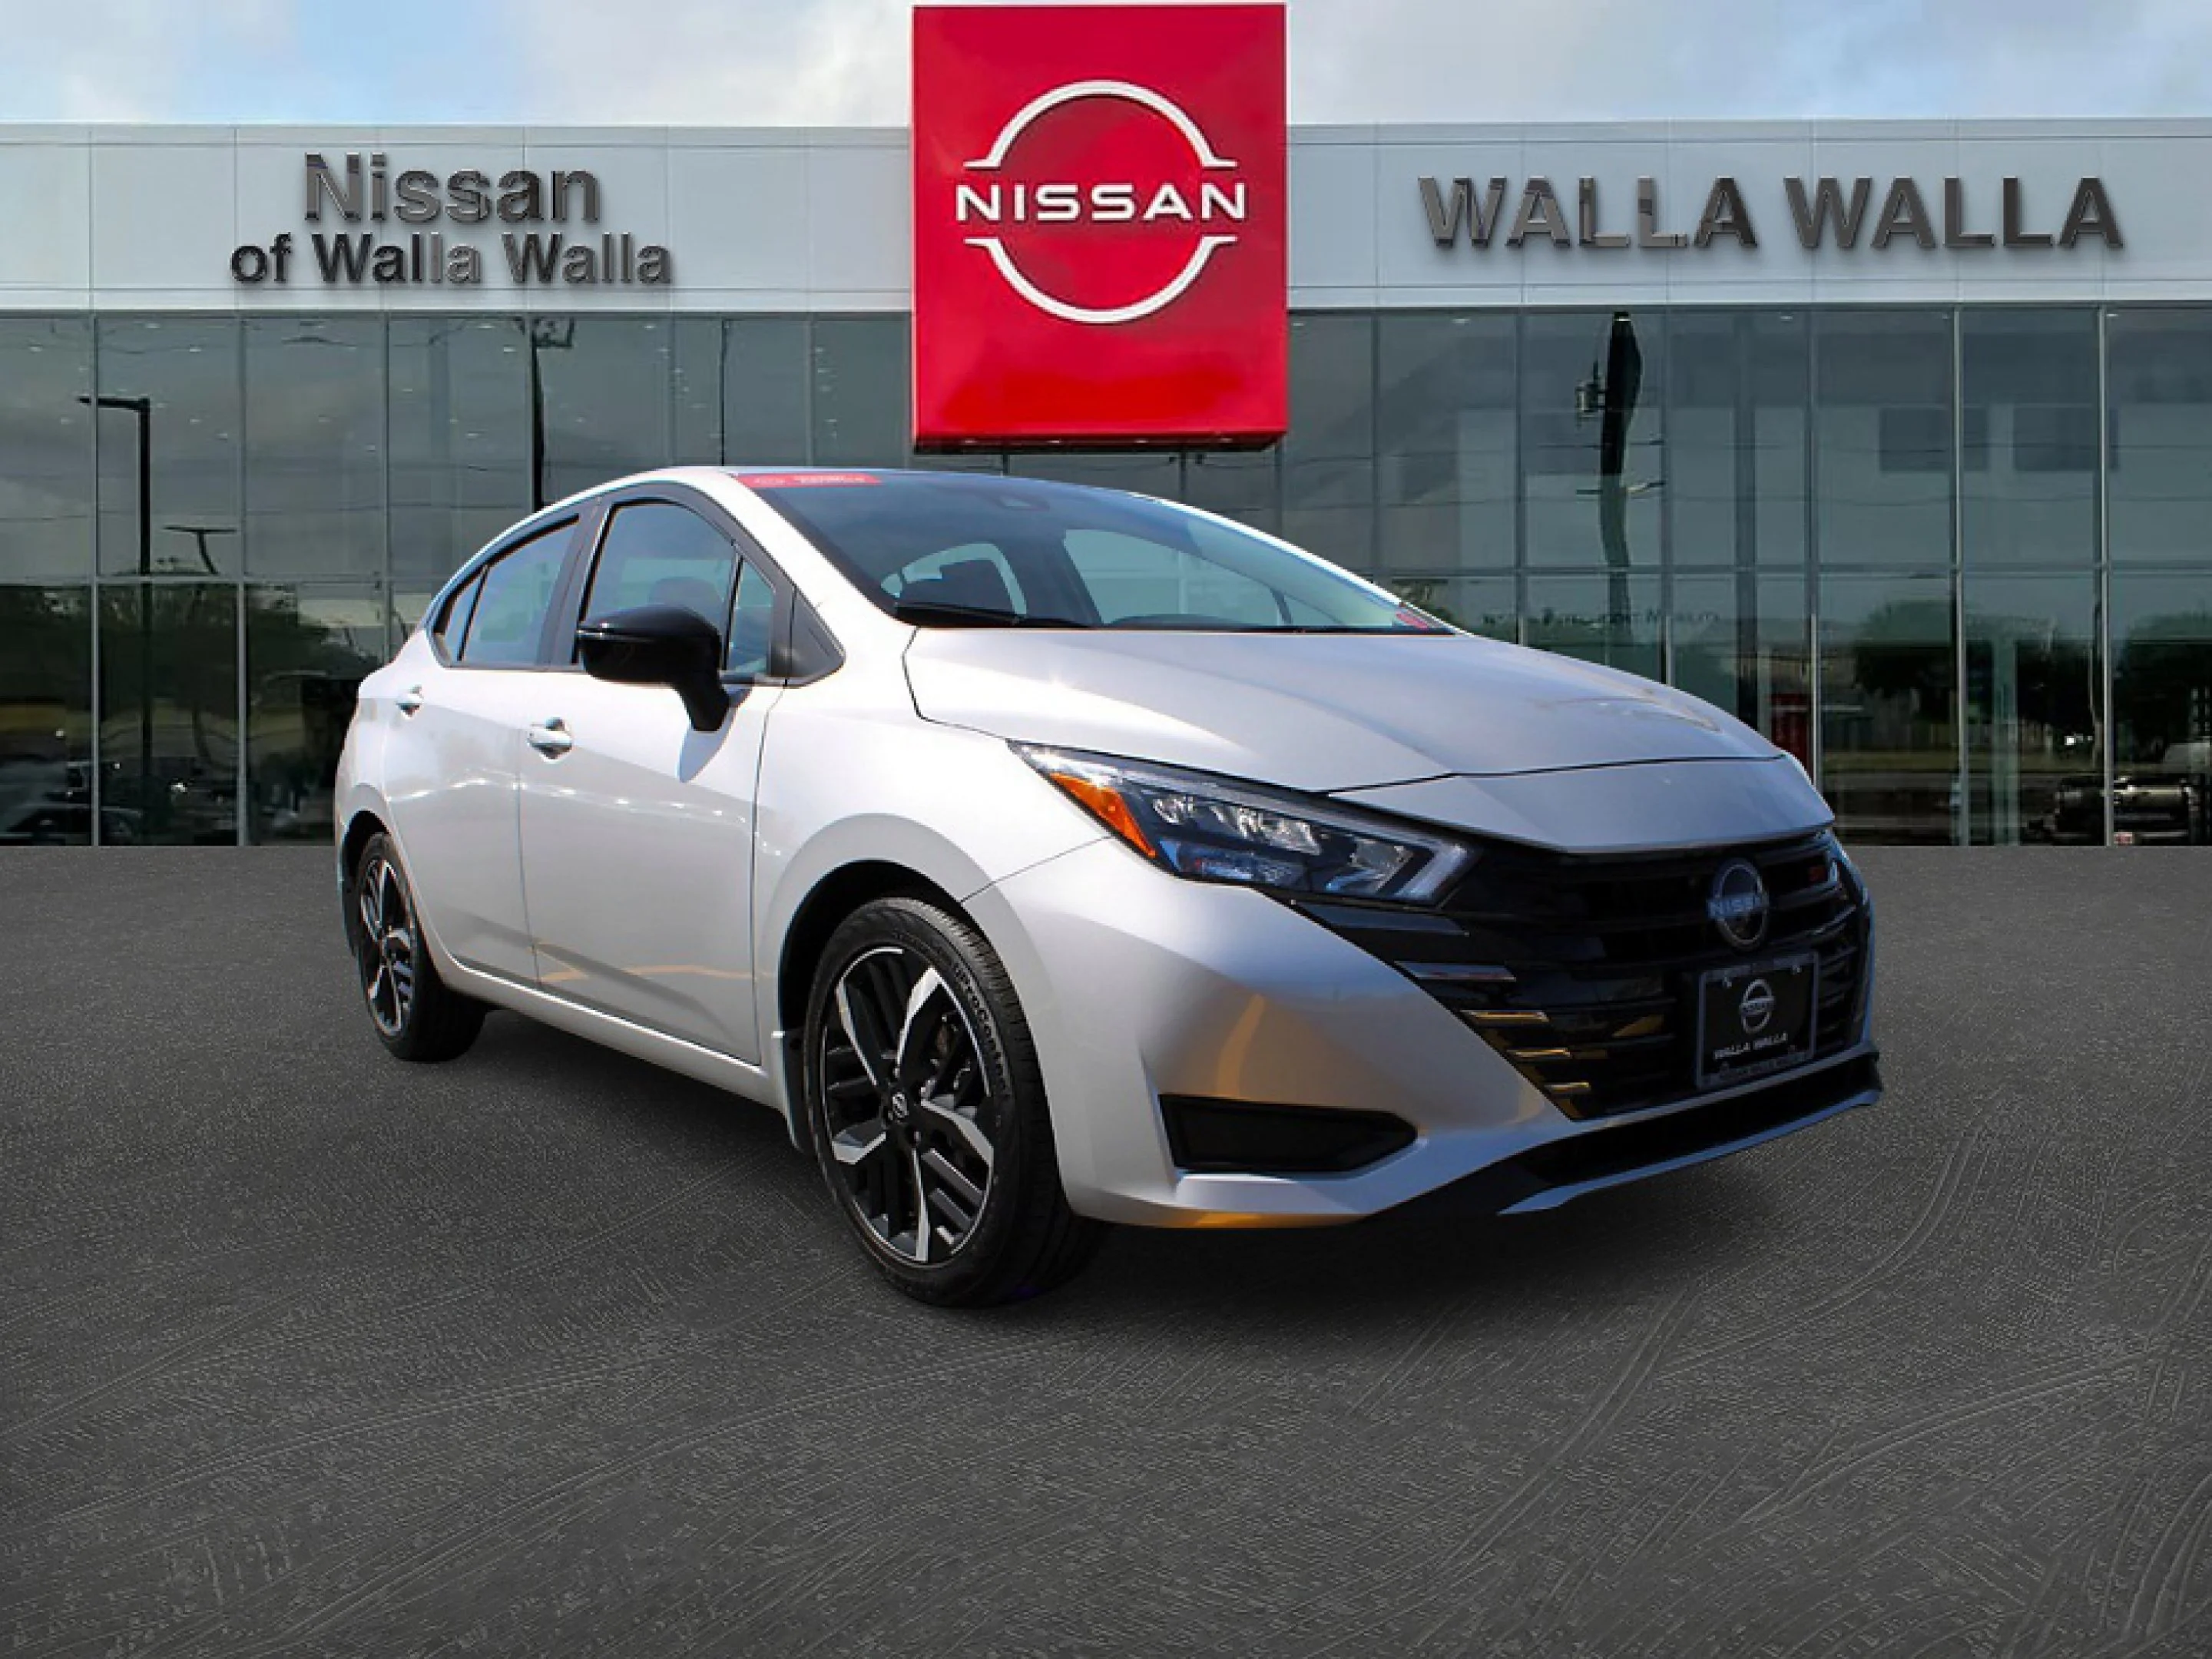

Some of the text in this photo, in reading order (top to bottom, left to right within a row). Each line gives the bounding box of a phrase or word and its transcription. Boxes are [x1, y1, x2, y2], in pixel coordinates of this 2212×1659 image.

[304, 153, 601, 224] Nissan
[956, 181, 1247, 223] NISSAN
[1419, 177, 2124, 250] WALLA WALLA
[230, 232, 672, 283] of Walla Walla
